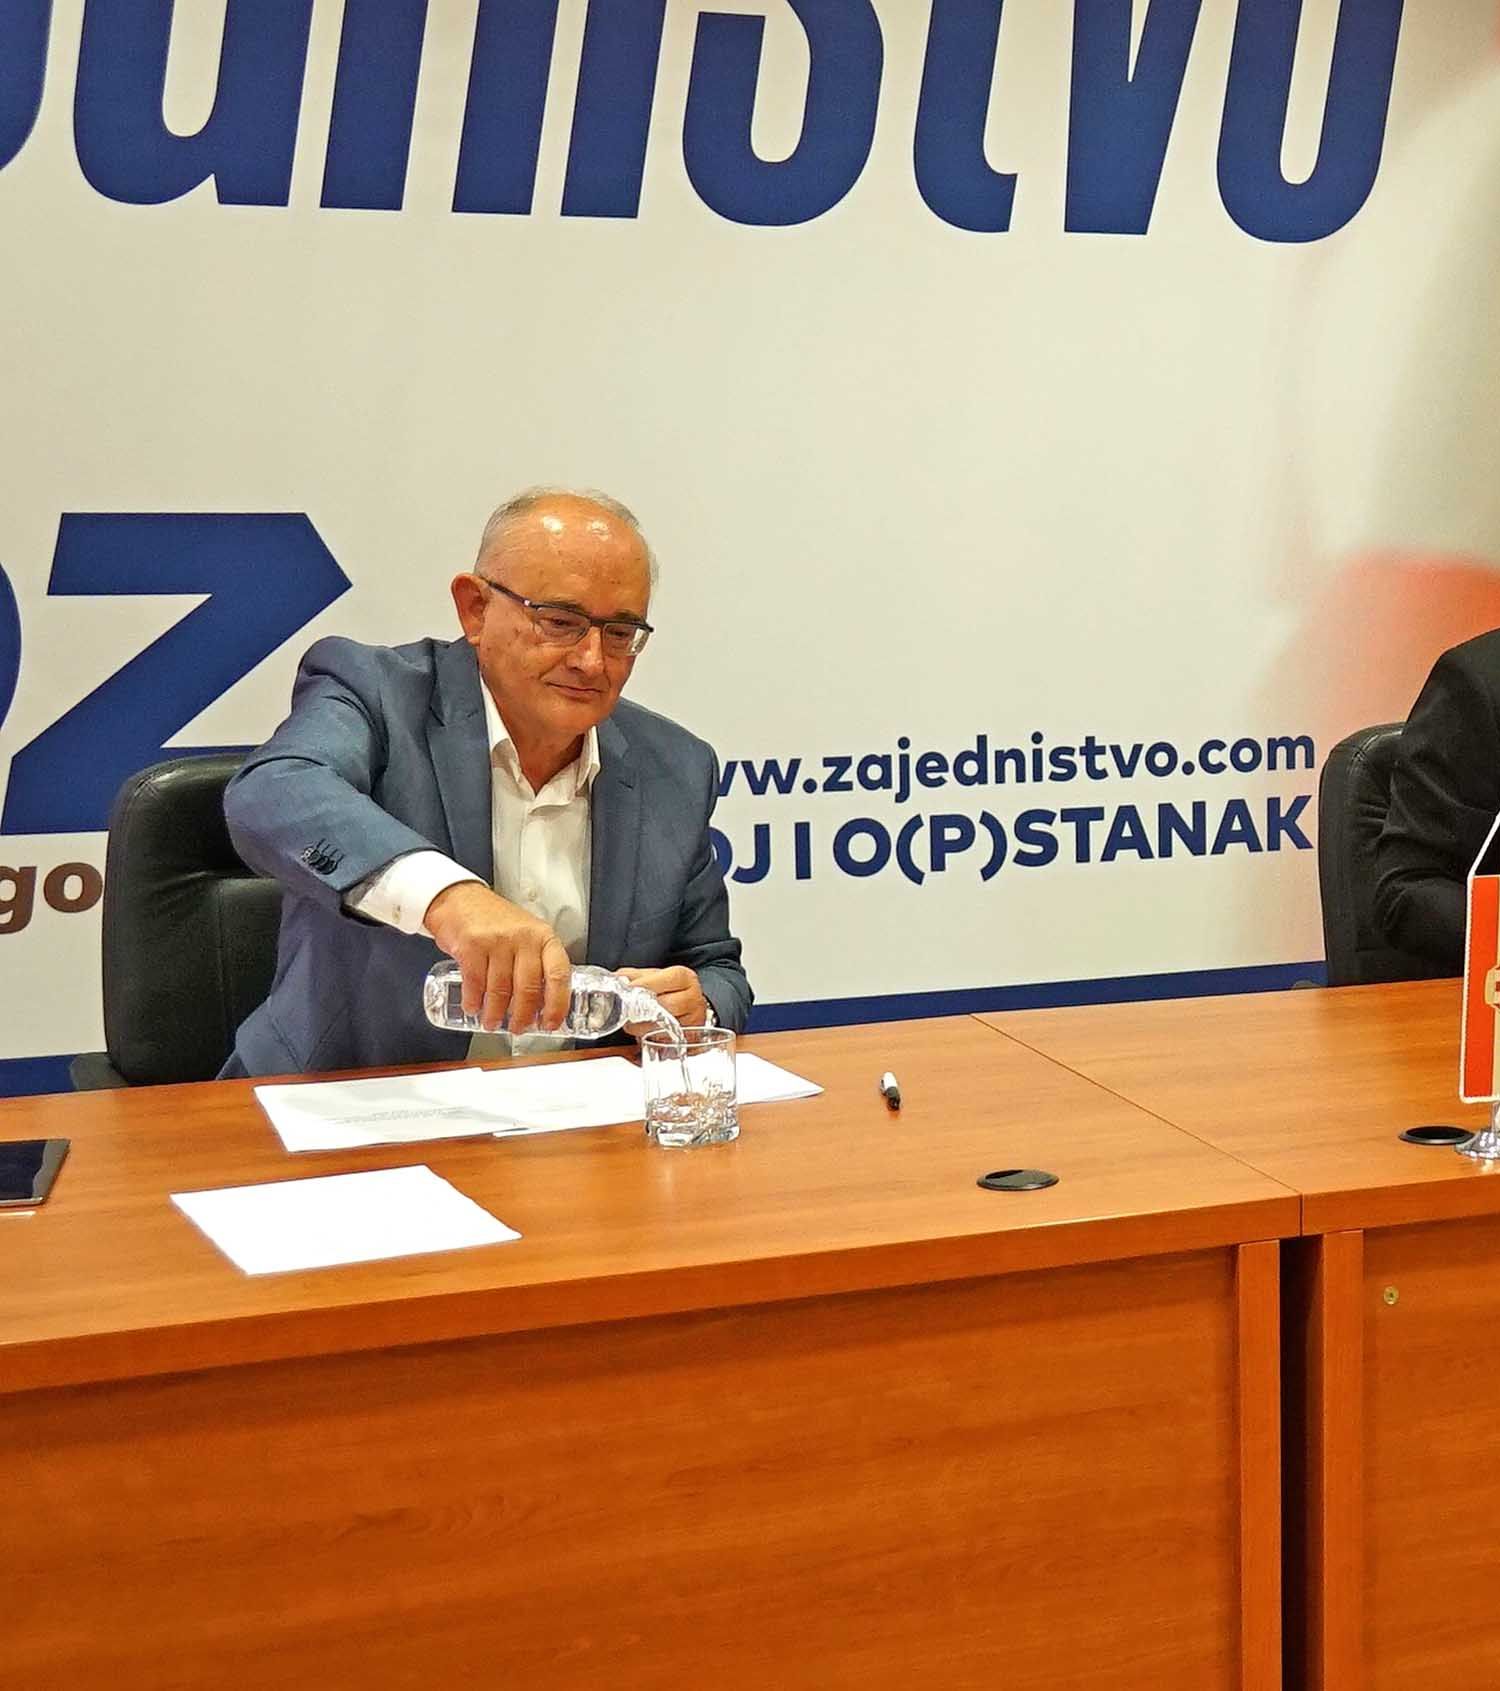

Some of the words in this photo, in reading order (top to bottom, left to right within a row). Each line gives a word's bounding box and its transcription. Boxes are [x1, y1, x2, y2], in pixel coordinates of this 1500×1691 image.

[0, 512, 353, 835] Z
[794, 821, 811, 880] I
[833, 795, 1314, 886] O(P)STANAK
